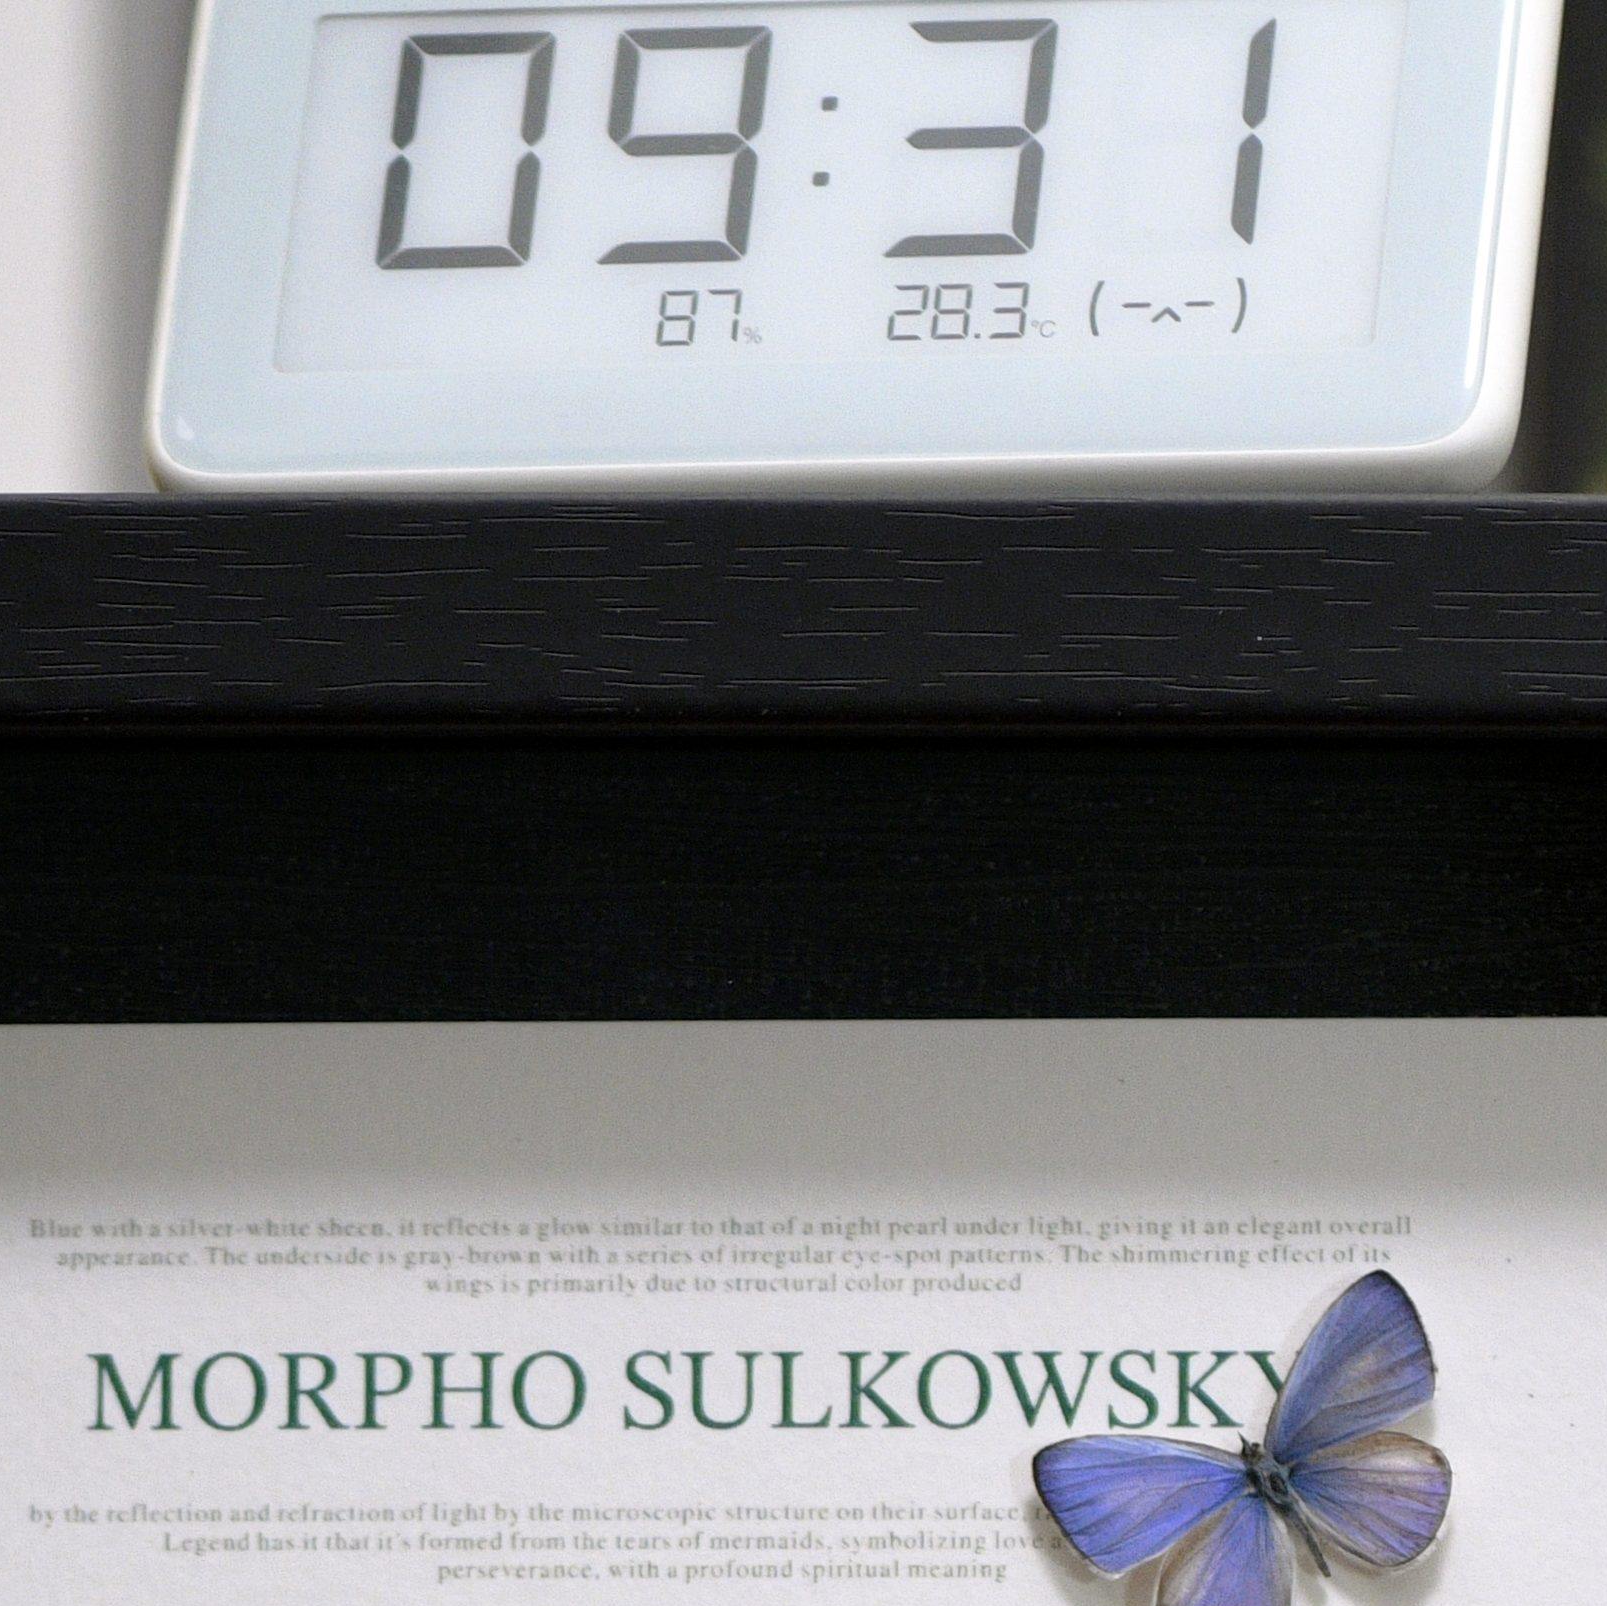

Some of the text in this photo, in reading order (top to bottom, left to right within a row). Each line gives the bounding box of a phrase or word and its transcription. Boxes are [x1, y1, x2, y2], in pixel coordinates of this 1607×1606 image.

[376, 17, 1277, 269] 09:31
[28, 1218, 81, 1237] Blue
[91, 1218, 143, 1237] with
[422, 1218, 510, 1237] reflects
[536, 1218, 591, 1243] glow
[601, 1218, 683, 1237] similar
[720, 1218, 765, 1237] that
[820, 1218, 881, 1243] night
[887, 1218, 948, 1243] pearl
[954, 1218, 1019, 1237] under
[1098, 1218, 1172, 1243] giving
[1236, 1218, 1322, 1243] elegant
[1328, 1218, 1412, 1237] overall
[255, 1246, 370, 1265] underside
[549, 1246, 600, 1265] with
[626, 1246, 692, 1265] series
[731, 1246, 833, 1270] irregular
[1110, 1246, 1250, 1270] shimmering
[1257, 1246, 1325, 1265] effect
[424, 1273, 1023, 1297] wings primarily due structural color produced
[86, 1349, 587, 1431] MORPHO
[105, 1503, 223, 1523] reflection
[276, 1503, 396, 1523] refraction
[430, 1503, 487, 1528] light
[570, 1503, 715, 1528] microscopic
[724, 1503, 830, 1523] structure
[870, 1503, 925, 1523] their
[161, 1532, 251, 1556] Legend
[255, 1532, 296, 1551] has
[324, 1532, 370, 1551] that
[417, 1532, 504, 1551] formed
[509, 1532, 566, 1551] from
[614, 1532, 670, 1551] tears
[840, 1532, 986, 1556] symbolizing
[994, 1532, 1045, 1551] love
[607, 1560, 660, 1580] with
[683, 1560, 794, 1585] profound
[801, 1560, 901, 1585] spiritual
[906, 1560, 1007, 1585] meaning
